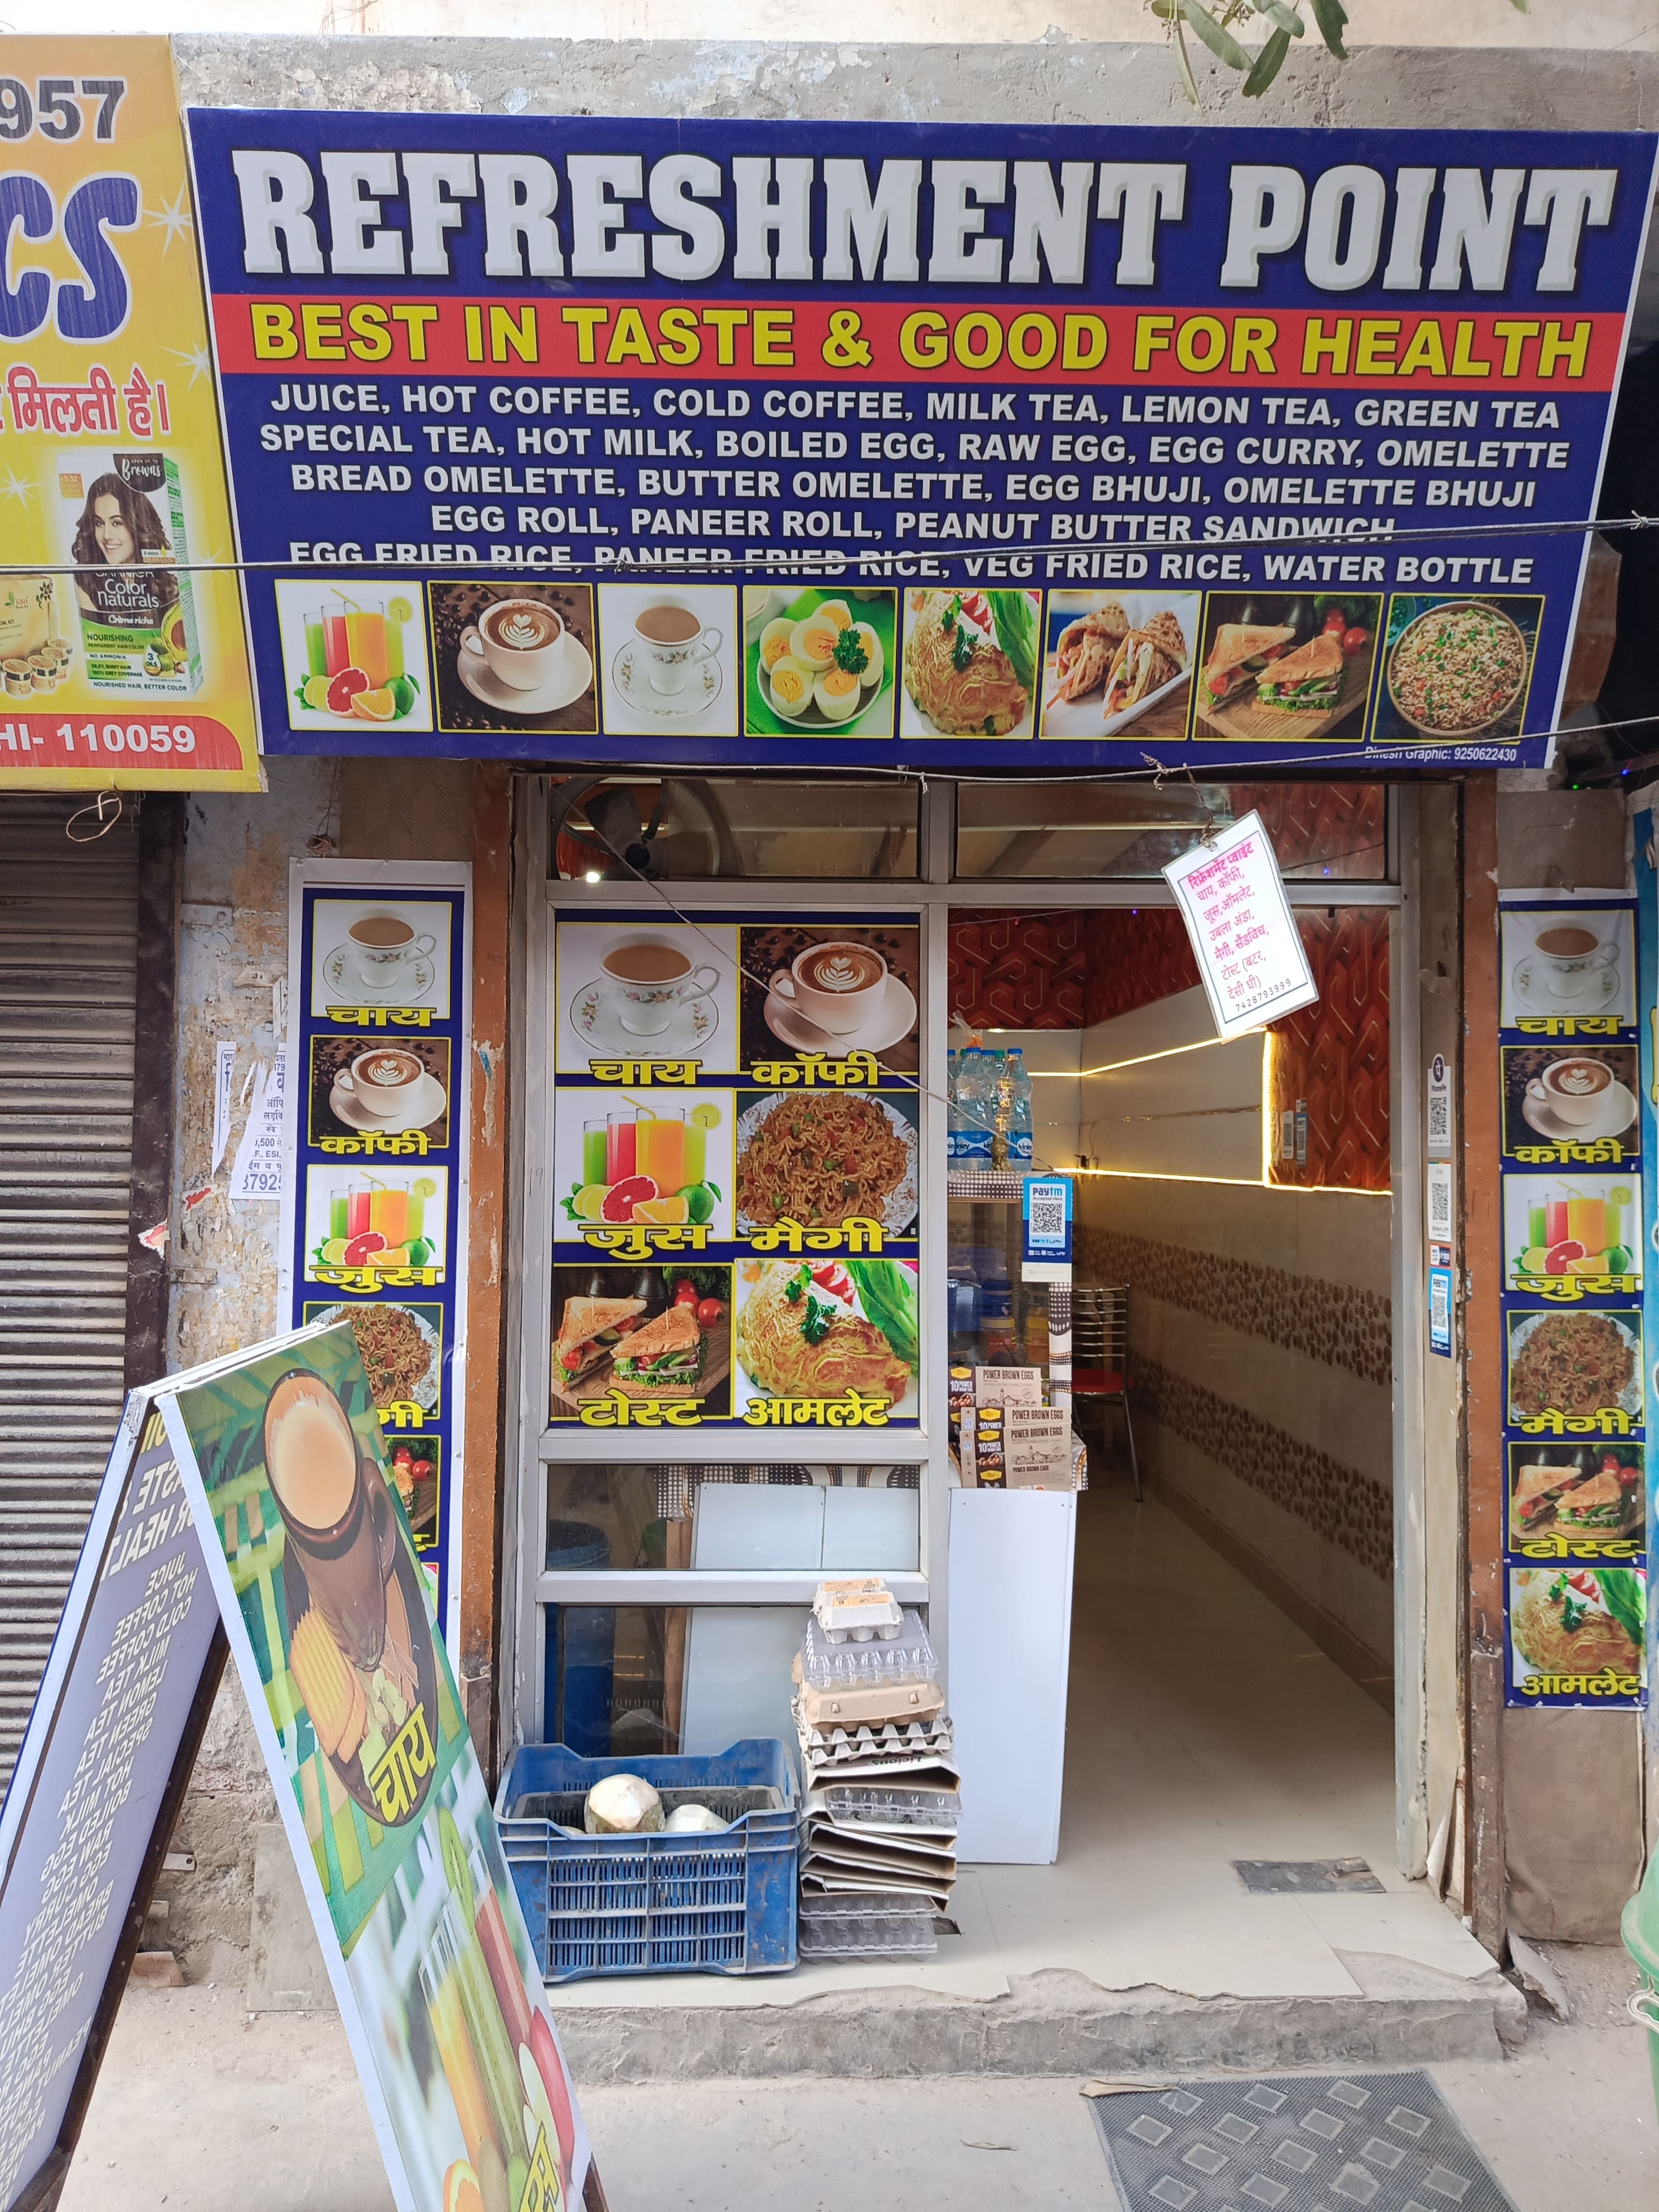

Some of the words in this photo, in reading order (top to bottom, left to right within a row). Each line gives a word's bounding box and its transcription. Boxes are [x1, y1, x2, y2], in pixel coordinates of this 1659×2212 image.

[232, 151, 1186, 284] REFRESHMENT
[1220, 166, 1617, 290] POINT
[252, 304, 435, 360] BEST
[467, 307, 536, 361] IN
[564, 308, 793, 365] TASTE
[823, 311, 871, 366] &
[901, 312, 1107, 368] GOOD
[1134, 317, 1276, 372] FOR
[1302, 319, 1590, 376] HEALTH
[8, 367, 118, 431] मिलती
[271, 385, 389, 414] JUICE,
[402, 386, 476, 412] HOT
[490, 387, 639, 417] COFFEE,
[654, 389, 749, 416] COLD
[764, 391, 912, 421] COFFEE,
[928, 393, 1016, 420] MILK
[1029, 395, 1108, 424] TEA,
[1123, 396, 1249, 423] LEMON
[1263, 398, 1340, 427] TEA,
[1355, 400, 1478, 426] GREEN
[1492, 402, 1559, 428] TEA
[261, 424, 413, 452] SPECIAL
[423, 426, 504, 455] TEA,
[517, 428, 590, 454] HOT
[605, 429, 702, 458] MILK,
[717, 431, 847, 458] BOILED
[861, 433, 944, 462] EGG,
[959, 434, 1040, 460] RAW
[1052, 435, 1135, 464] EGG,
[1150, 437, 1223, 463] EGG
[1237, 438, 1363, 467] CURRY,
[1377, 440, 1569, 468] OMELETTE
[292, 465, 411, 491] BREAD
[425, 466, 624, 497] OMELETTE,
[639, 470, 780, 497] BUTTER
[793, 472, 992, 502] OMELETTE,
[1007, 475, 1079, 500] EGG
[1093, 476, 1210, 505] BHUJI,
[1225, 478, 1415, 505] OMELETTE
[1426, 481, 1535, 506] BHUJI
[432, 506, 505, 531] EGG
[518, 507, 618, 535] ROLL,
[632, 509, 770, 535] PANEER
[783, 511, 881, 539] ROLL,
[896, 513, 1039, 539] PEANUT
[1051, 515, 1191, 540] BUTTER
[859, 550, 950, 579] RICE,
[964, 556, 1034, 578] VEG
[1045, 554, 1148, 578] FRIED
[1160, 554, 1250, 582] RICE,
[1263, 555, 1385, 581] WATER
[1395, 557, 1534, 584] BOTTLE
[86, 633, 134, 642] NOURISHING
[147, 652, 154, 661] 3
[57, 723, 195, 753] 110059
[1453, 747, 1517, 762] 9250622430
[1196, 885, 1217, 901] चाय,
[1217, 866, 1245, 889] कॉफी,
[1209, 920, 1232, 941] उबला
[1234, 909, 1255, 926] अंडा,
[1227, 981, 1245, 1000] देसी
[326, 1004, 438, 1027] चाय
[1515, 1016, 1622, 1036] चाय
[589, 1059, 702, 1085] चाय
[751, 1051, 880, 1086] कॉफी
[319, 1129, 432, 1156] कॉफी
[1514, 1137, 1624, 1164] कॉफी
[578, 1224, 714, 1261] जुस
[749, 1216, 889, 1252] मैगी
[308, 1265, 443, 1294] जुस
[983, 1369, 1001, 1380] POWER
[1002, 1369, 1020, 1380] BROWN
[1021, 1370, 1034, 1380] EGGS
[579, 1390, 705, 1426] टोस्ट
[743, 1387, 891, 1426] आमलेट
[1012, 1410, 1030, 1420] POWER
[1031, 1410, 1049, 1420] BROWN
[1051, 1410, 1064, 1420] EGGS
[1520, 1406, 1632, 1435] मैगी
[1011, 1429, 1029, 1439] POWER
[1030, 1428, 1049, 1438] BROWN
[1050, 1427, 1063, 1437] EGGS
[1521, 1532, 1641, 1559] टोस्ट
[1521, 1672, 1641, 1697] आमलेट
[370, 1701, 438, 1825] चाय
